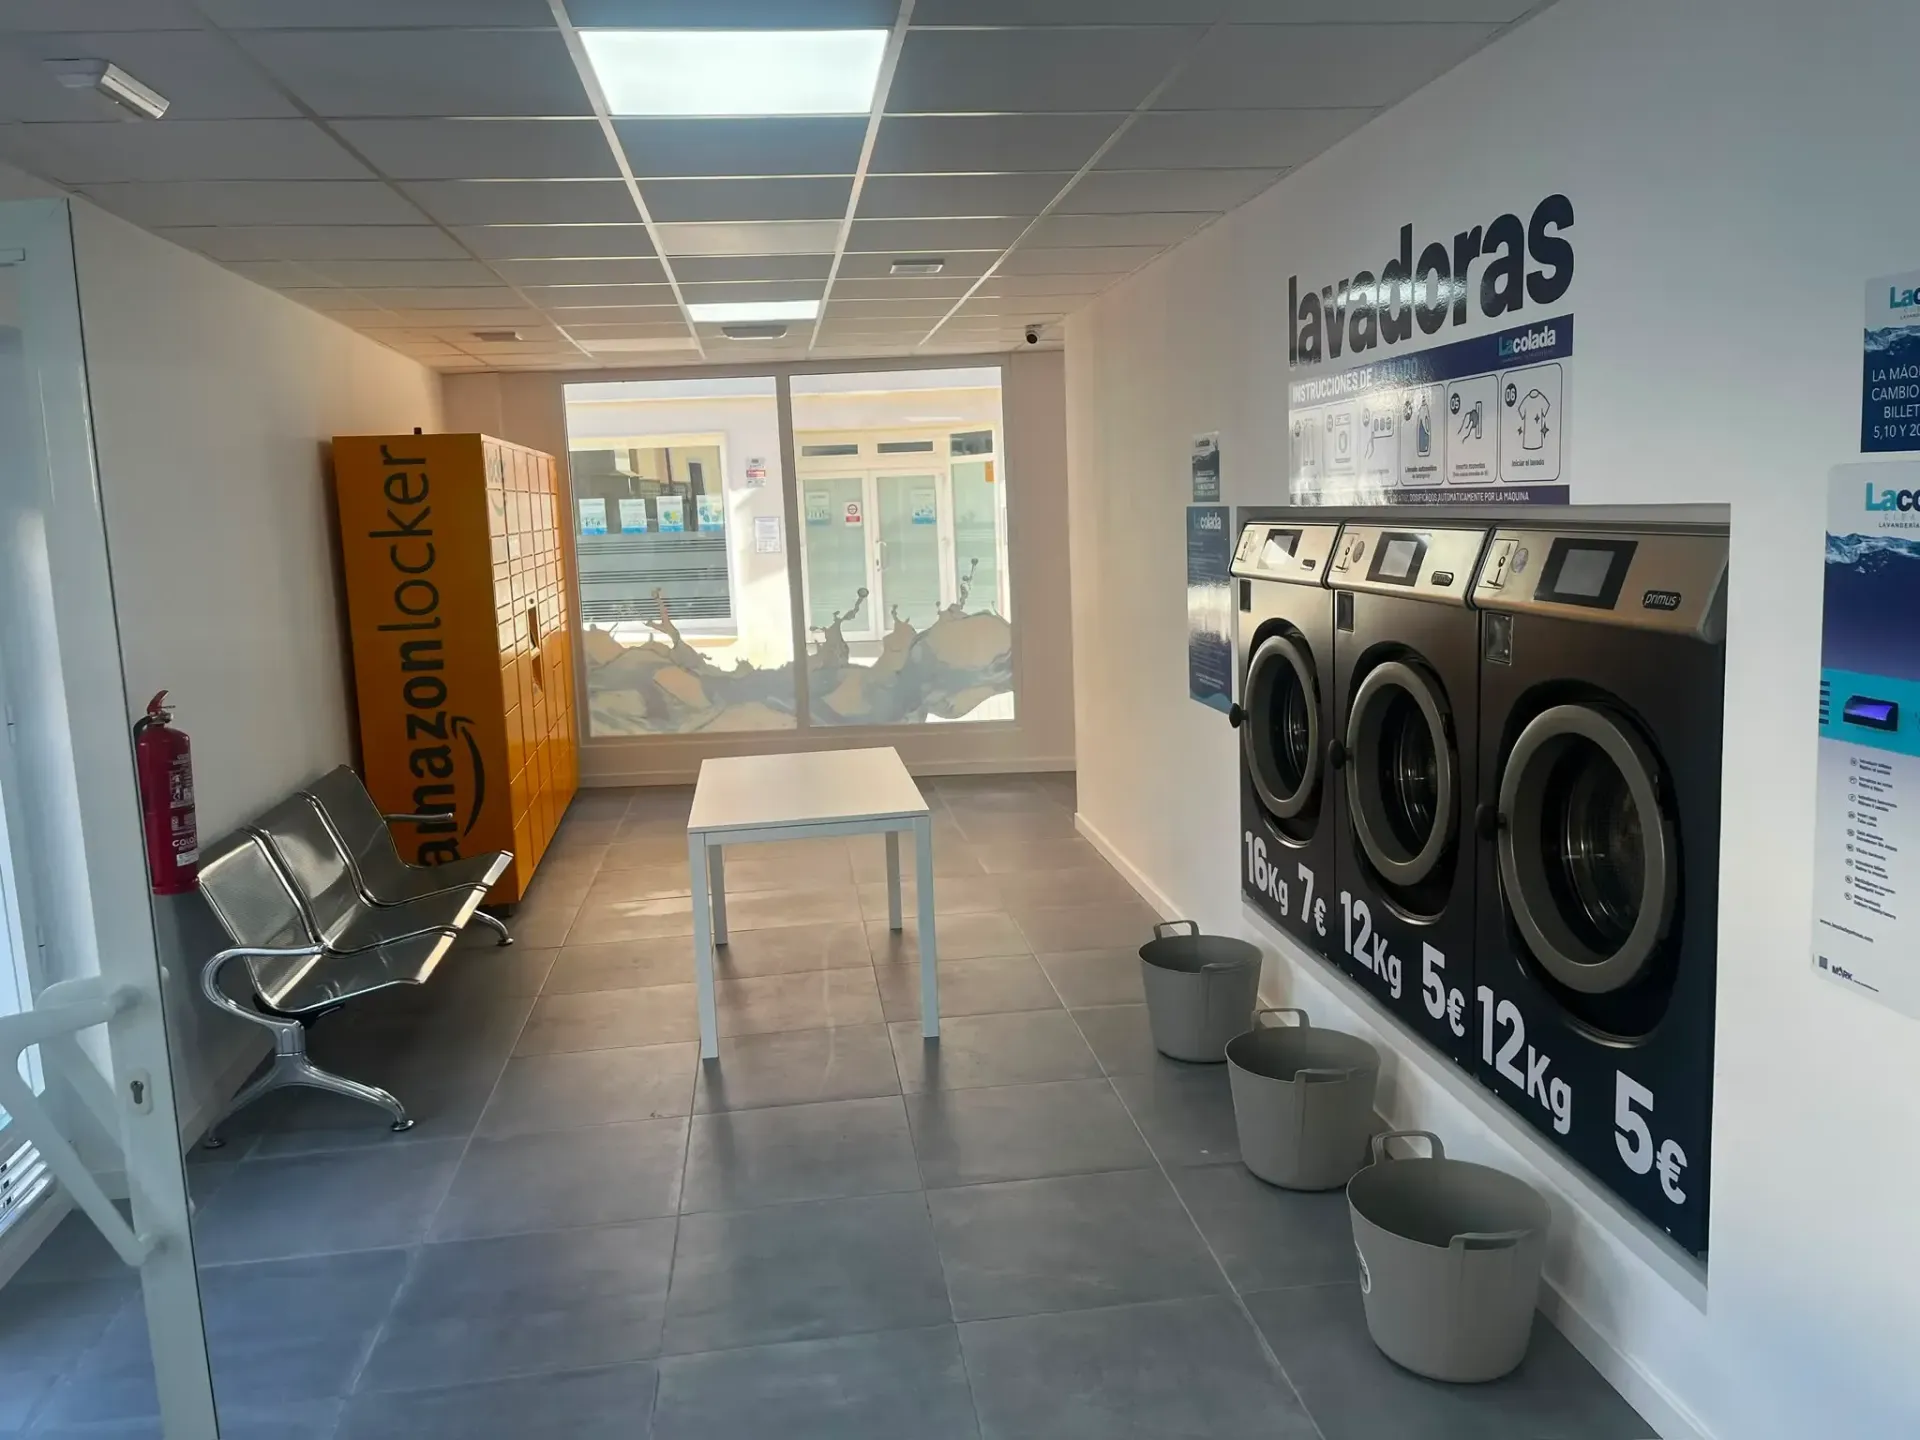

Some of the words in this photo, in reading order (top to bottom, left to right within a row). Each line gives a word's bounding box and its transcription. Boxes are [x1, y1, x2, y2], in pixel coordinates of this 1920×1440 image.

[1288, 193, 1575, 369] lavadoras
[1498, 325, 1556, 356] Lacolada
[1292, 370, 1358, 402] INSTRUCCIONES
[1360, 367, 1372, 390] DE
[1872, 368, 1887, 383] LA
[1889, 363, 1920, 381] MÁQ
[1506, 387, 1517, 402] 06
[1871, 384, 1920, 401] CAMBIO
[1873, 424, 1897, 441] 5,10
[1899, 423, 1907, 437] Y
[1484, 491, 1495, 502] POR
[1495, 491, 1503, 502] LA
[1643, 592, 1678, 608] primus
[1245, 830, 1289, 916] 16Kg
[1298, 862, 1327, 937] 7€
[1340, 890, 1402, 999] 12Kg
[1422, 941, 1466, 1037] 5€
[1477, 985, 1572, 1135] 12Kg
[1614, 1069, 1688, 1205] 5€
